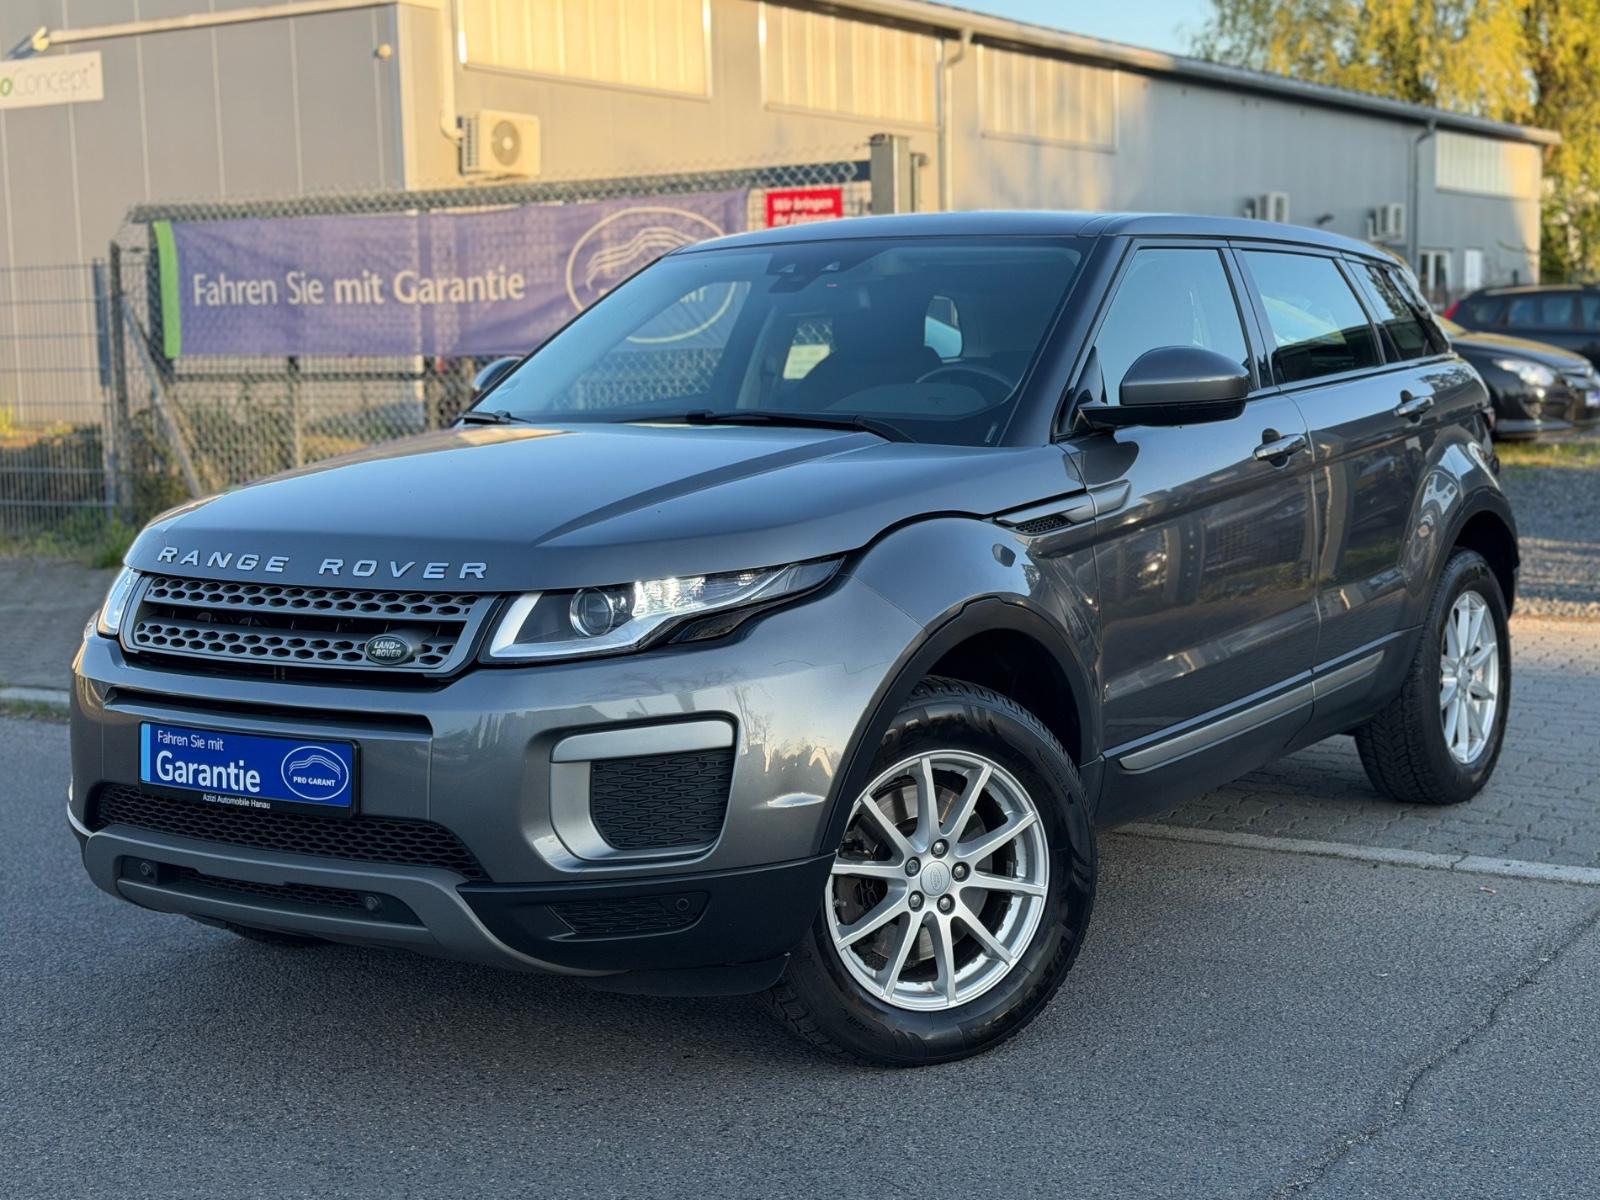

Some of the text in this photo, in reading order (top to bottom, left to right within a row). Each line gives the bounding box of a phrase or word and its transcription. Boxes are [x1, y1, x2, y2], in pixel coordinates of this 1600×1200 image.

[193, 267, 525, 306] Fahren Sie mit Garantie
[157, 546, 488, 580] RANGE ROVER
[374, 641, 396, 649] LAND
[375, 649, 402, 657] ROVER
[157, 730, 225, 752] Fahren Sie mit
[156, 750, 261, 793] Garantie
[293, 776, 336, 787] PRO GARANT
[217, 795, 250, 807] Automobile
[250, 799, 271, 810] Hanau
